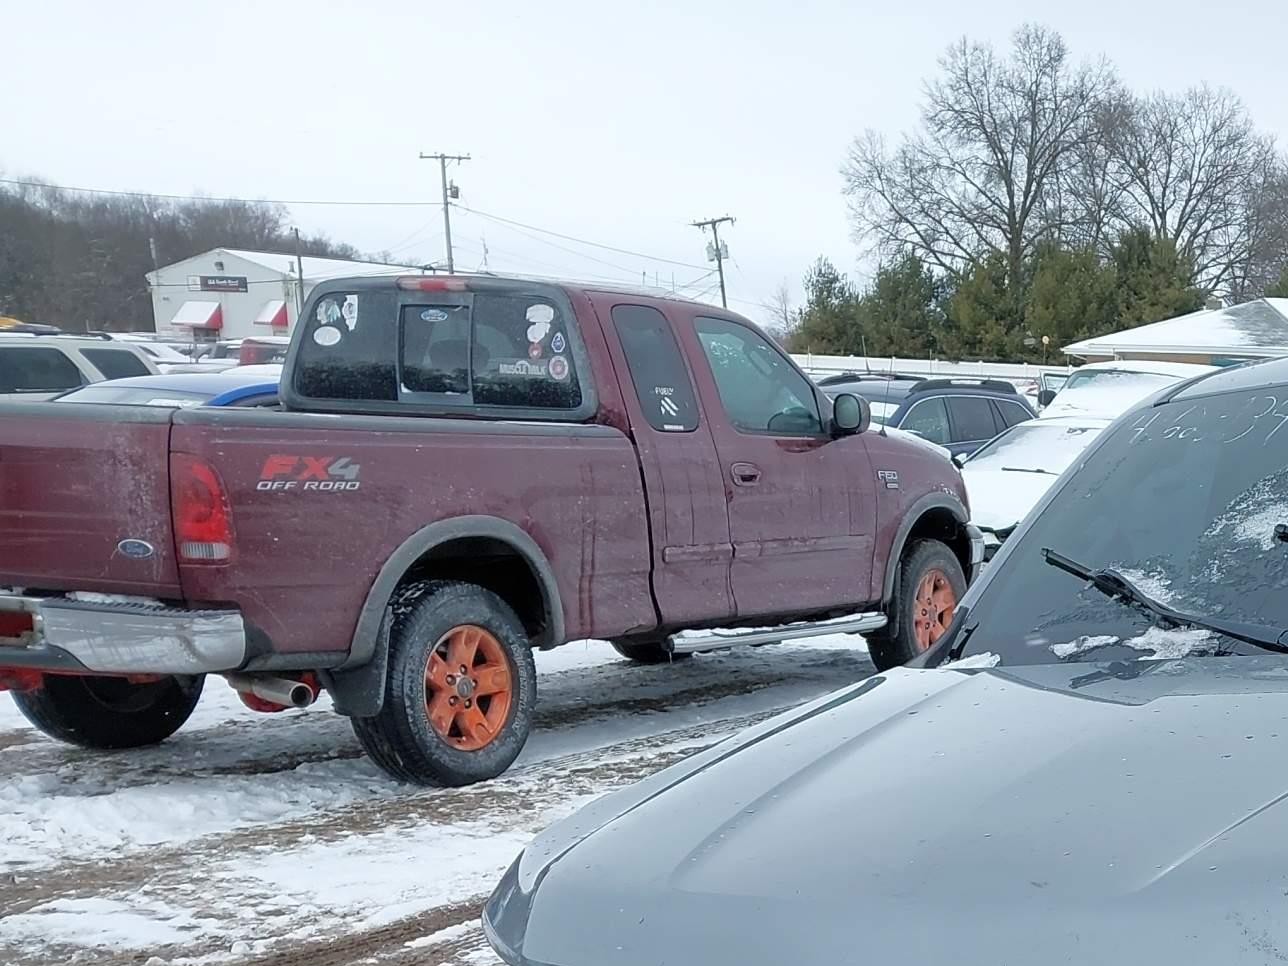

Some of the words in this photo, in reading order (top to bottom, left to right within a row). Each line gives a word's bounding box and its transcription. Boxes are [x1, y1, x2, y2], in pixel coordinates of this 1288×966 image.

[260, 454, 361, 480] FX4
[256, 481, 298, 491] OFF
[303, 481, 361, 491] ROAD
